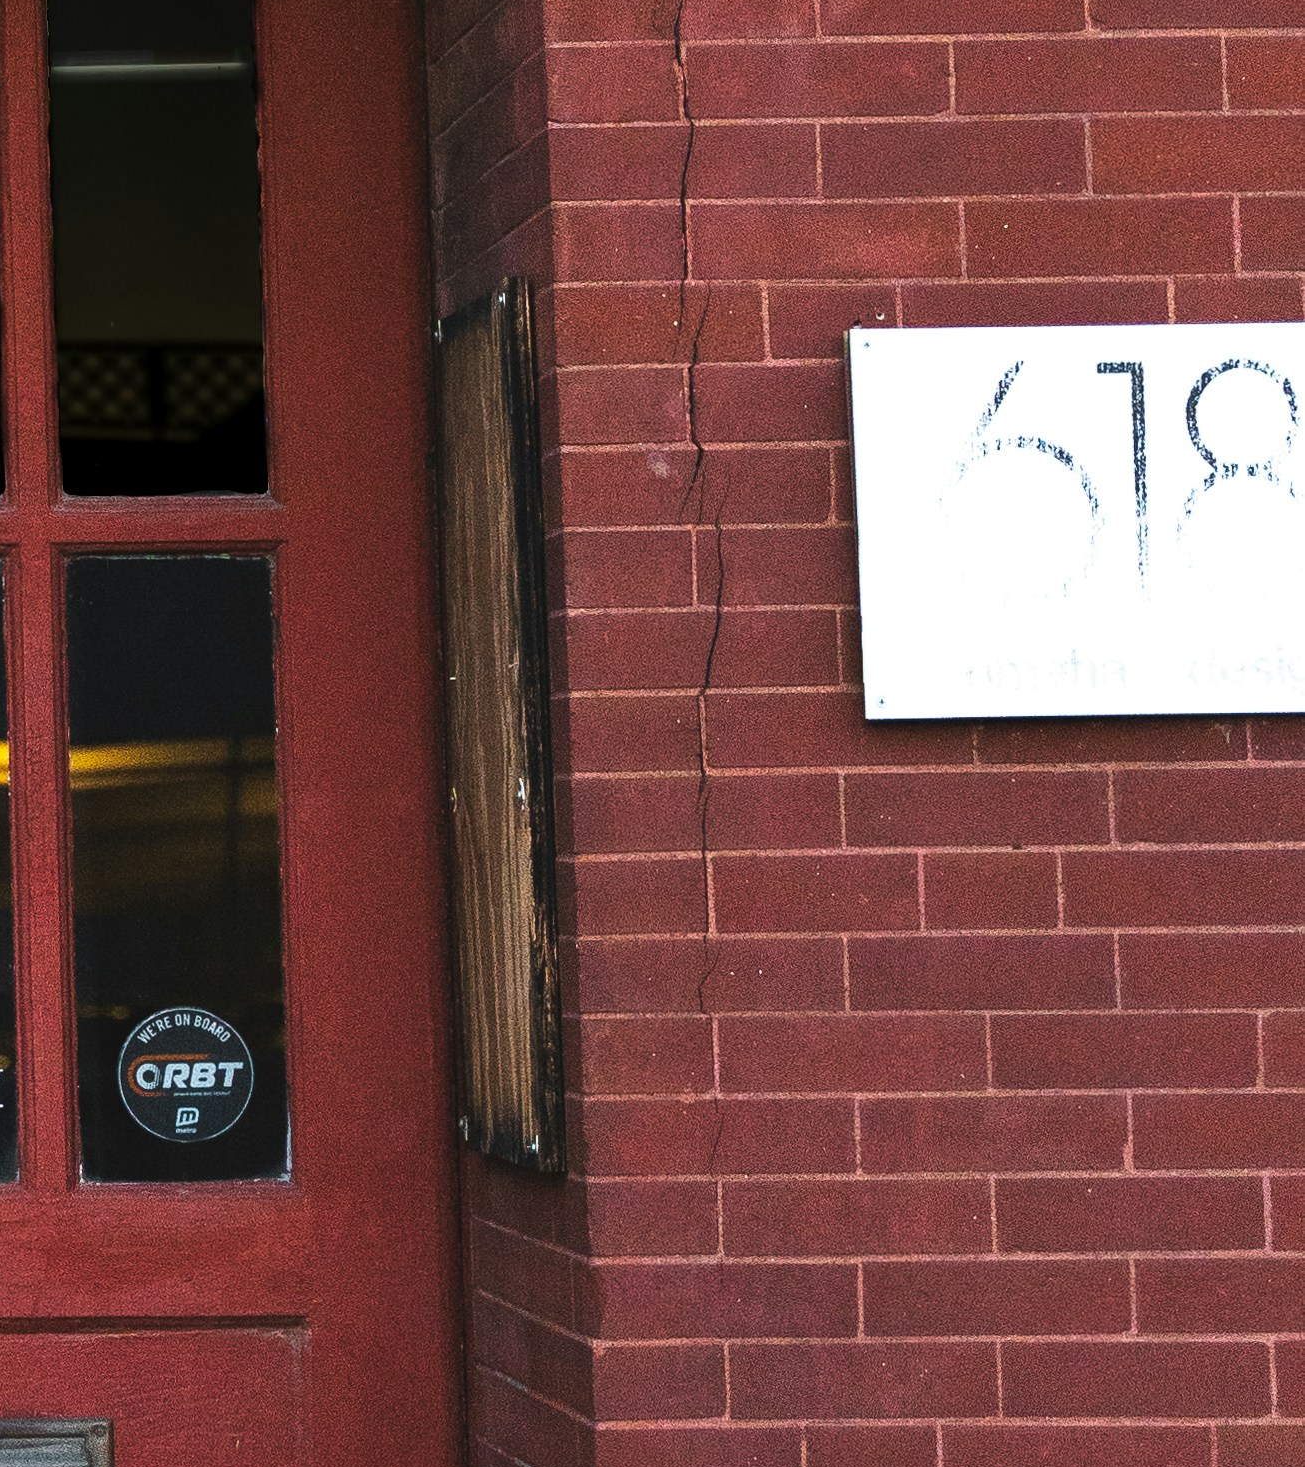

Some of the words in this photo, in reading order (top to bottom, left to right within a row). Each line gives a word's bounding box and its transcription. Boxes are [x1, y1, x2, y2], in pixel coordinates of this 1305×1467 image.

[136, 1016, 172, 1044] WE'RE
[174, 1013, 191, 1027] ON
[193, 1015, 231, 1043] BOARD
[135, 1062, 244, 1090] ORBT
